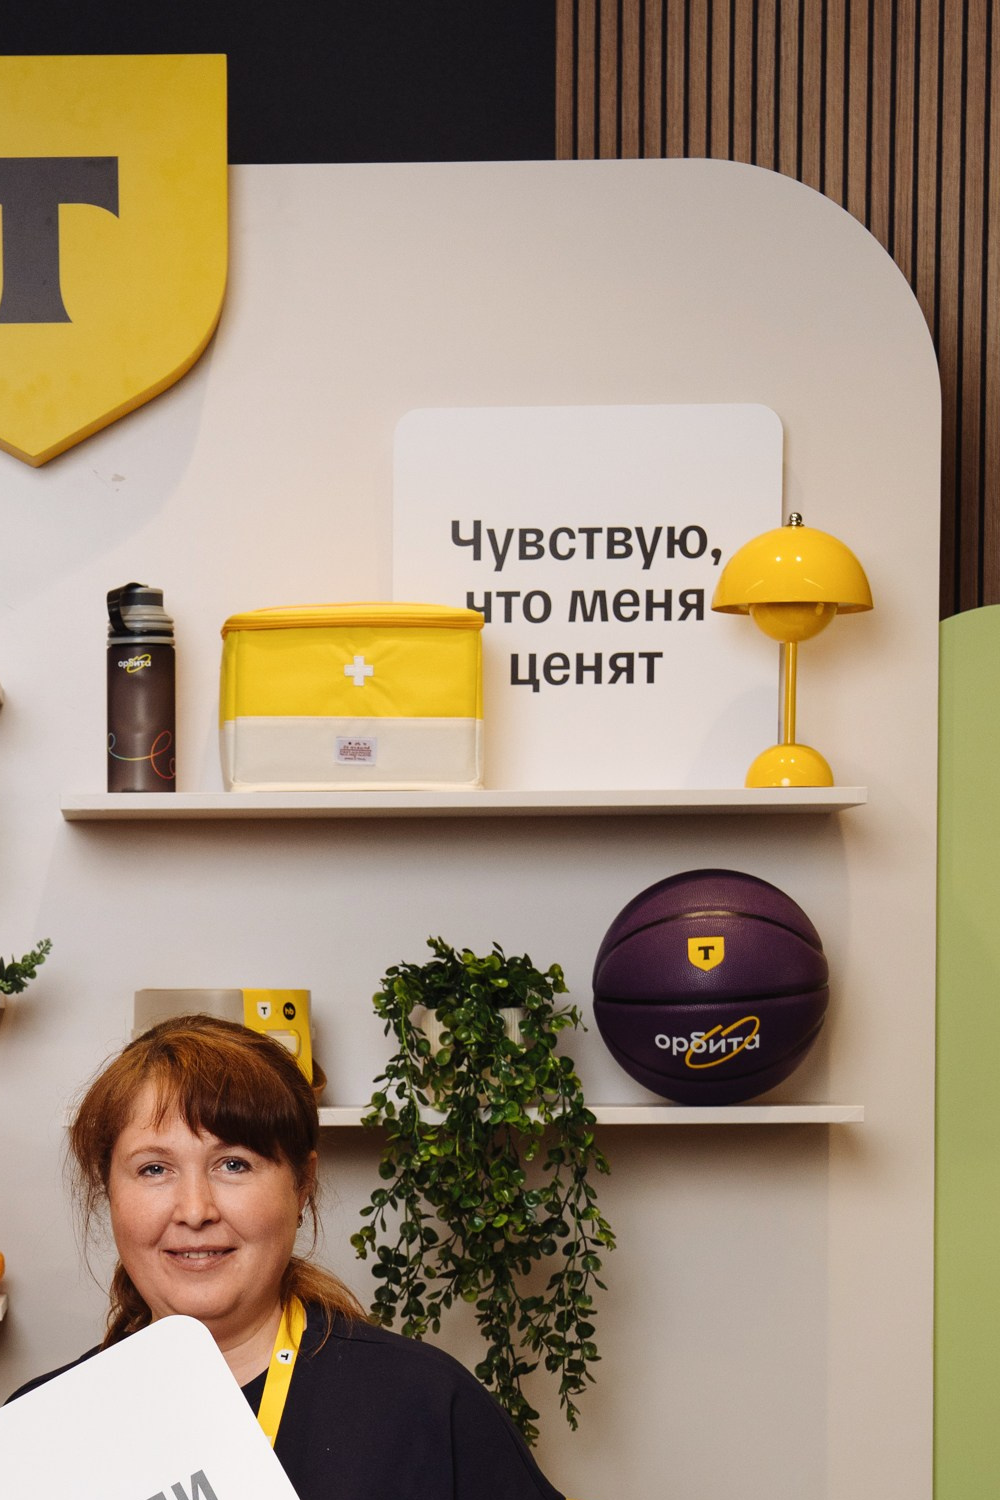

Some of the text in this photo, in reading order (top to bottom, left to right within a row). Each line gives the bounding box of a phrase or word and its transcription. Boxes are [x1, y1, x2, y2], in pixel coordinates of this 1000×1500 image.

[451, 519, 722, 572] Чувствую,
[466, 588, 705, 624] что меня
[510, 651, 664, 693] ценят
